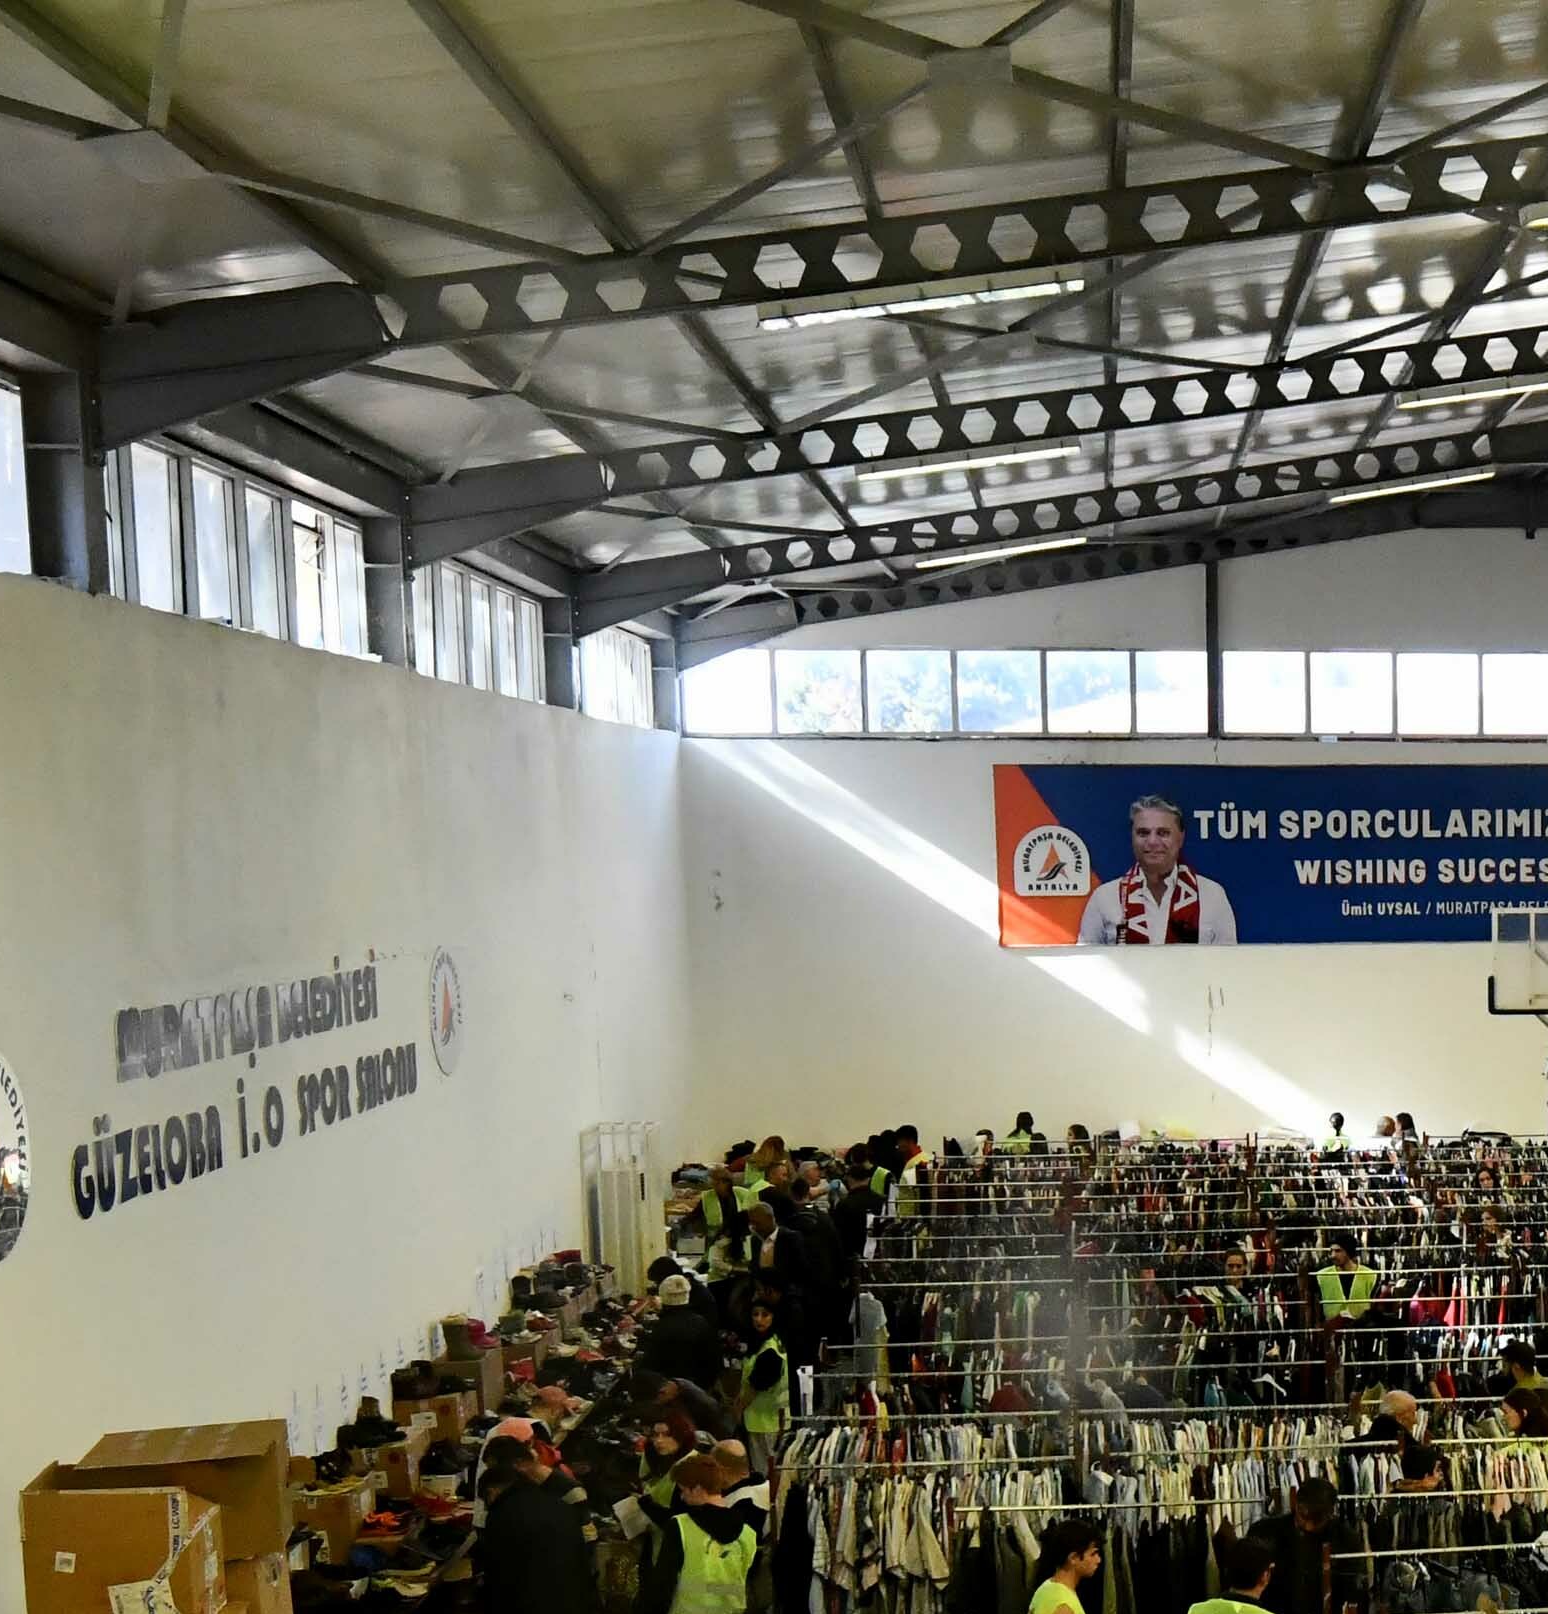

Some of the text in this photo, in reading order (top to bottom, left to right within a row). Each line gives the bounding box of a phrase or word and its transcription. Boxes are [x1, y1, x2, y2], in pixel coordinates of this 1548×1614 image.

[1193, 802, 1267, 839] TÜM
[1294, 857, 1427, 885] WISHING
[1341, 900, 1373, 916] Ümit
[1377, 901, 1421, 916] UYSAL
[72, 1104, 224, 1221] GÜZELOBA
[298, 1063, 352, 1137] SPOR
[356, 1042, 418, 1114] SALONU
